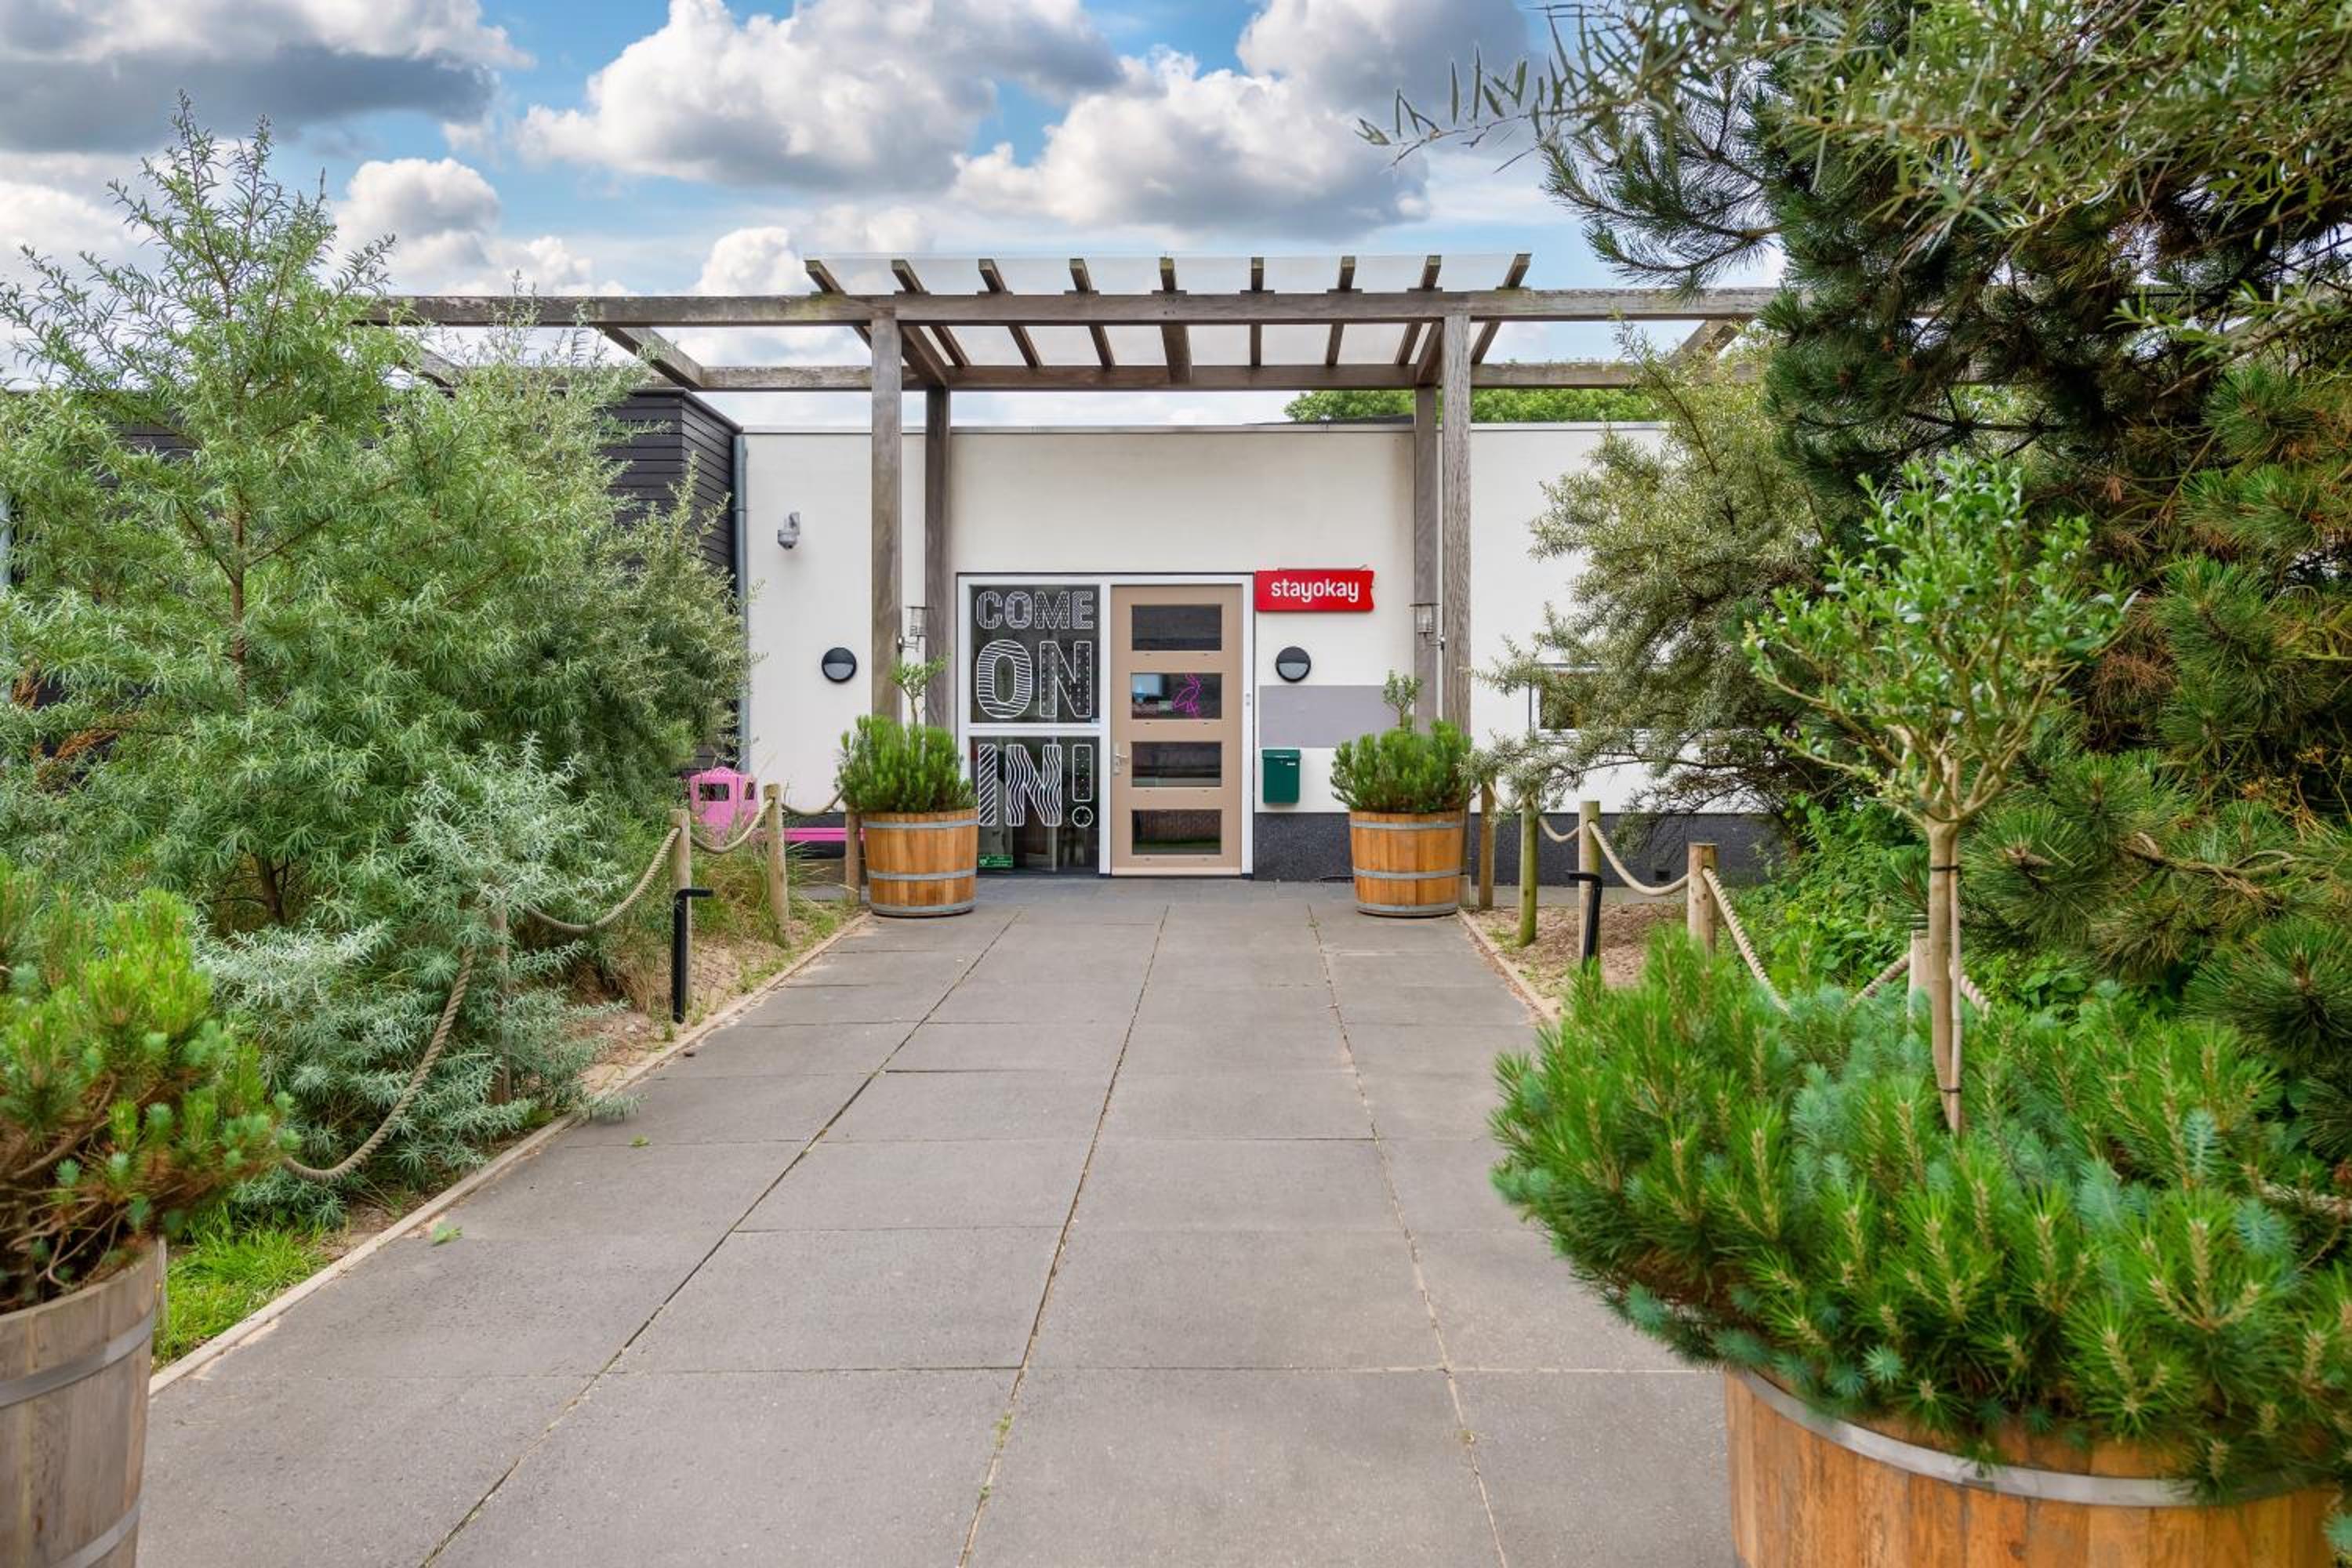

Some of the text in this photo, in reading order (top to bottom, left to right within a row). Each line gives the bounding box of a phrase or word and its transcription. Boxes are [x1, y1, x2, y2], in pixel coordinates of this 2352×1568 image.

[976, 590, 1094, 630] COME
[1270, 578, 1359, 603] stayokay
[976, 639, 1092, 719] ON
[978, 743, 1094, 828] IN!
